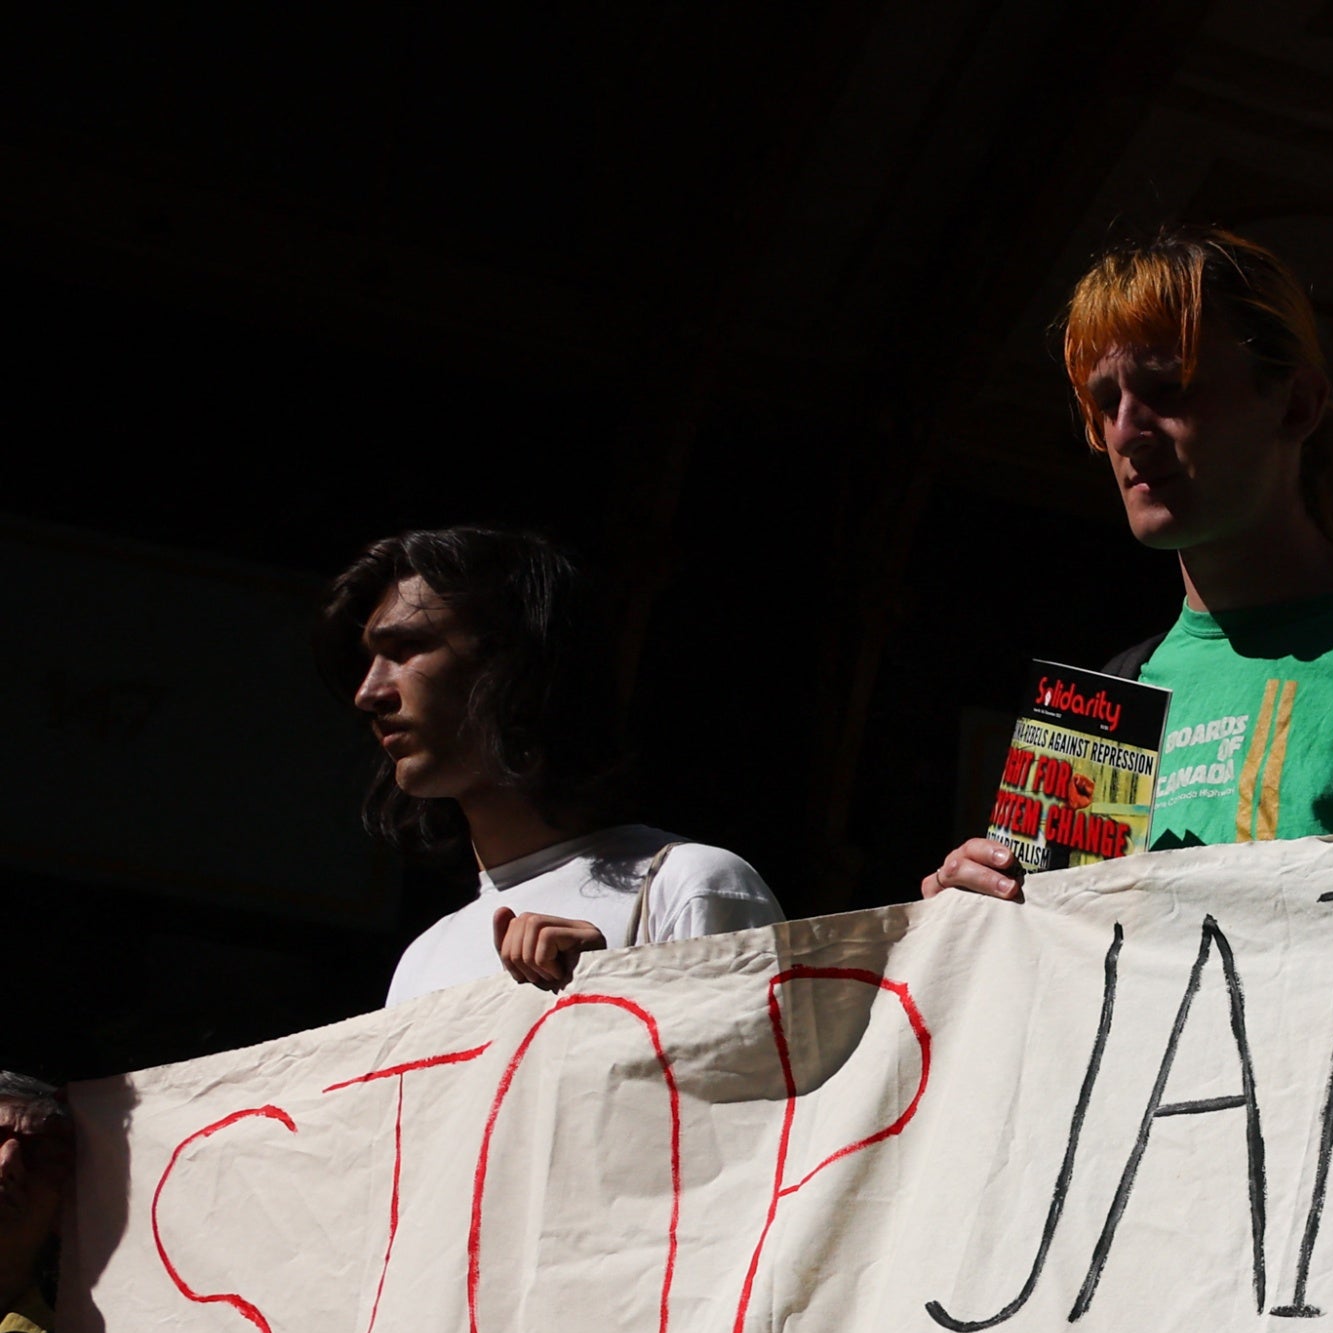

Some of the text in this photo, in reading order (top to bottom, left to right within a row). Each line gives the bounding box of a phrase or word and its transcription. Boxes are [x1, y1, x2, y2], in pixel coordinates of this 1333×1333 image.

[1035, 676, 1122, 732] Solidarity
[1048, 731, 1090, 760] AGAINST
[1090, 741, 1155, 776] REPRESSION
[1165, 714, 1250, 754] BOARDS
[1216, 735, 1245, 762] OF
[1031, 755, 1073, 800] FOR
[1155, 758, 1235, 798] CANADA
[1045, 804, 1132, 859] CHANGE
